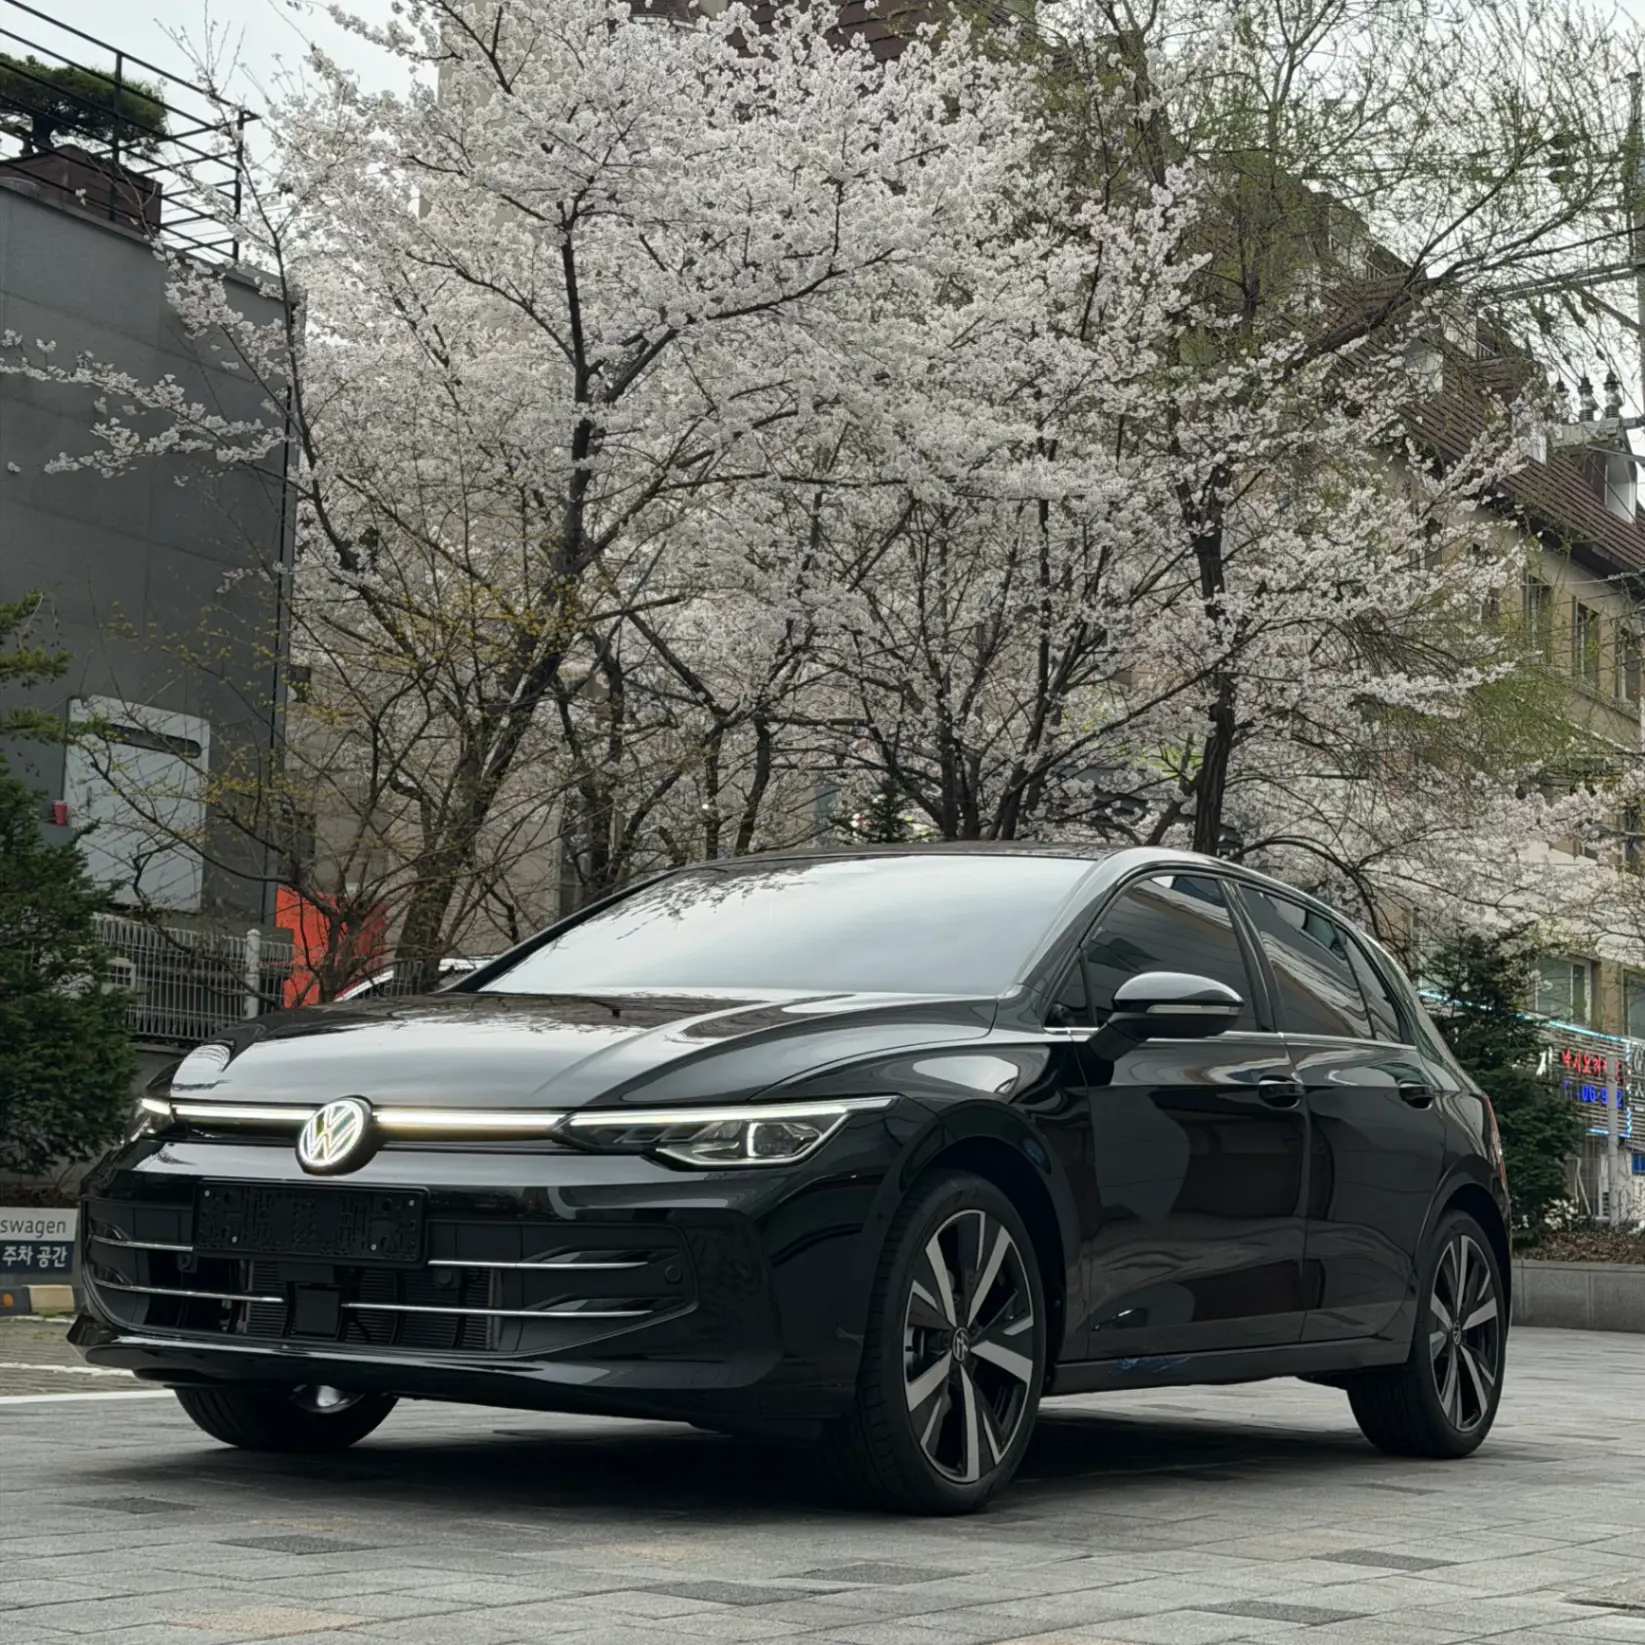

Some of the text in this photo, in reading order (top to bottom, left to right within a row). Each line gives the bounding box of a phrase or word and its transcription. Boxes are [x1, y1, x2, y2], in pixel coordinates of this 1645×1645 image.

[0, 1219, 66, 1239] swagen
[2, 1245, 68, 1268] 주차 공간
